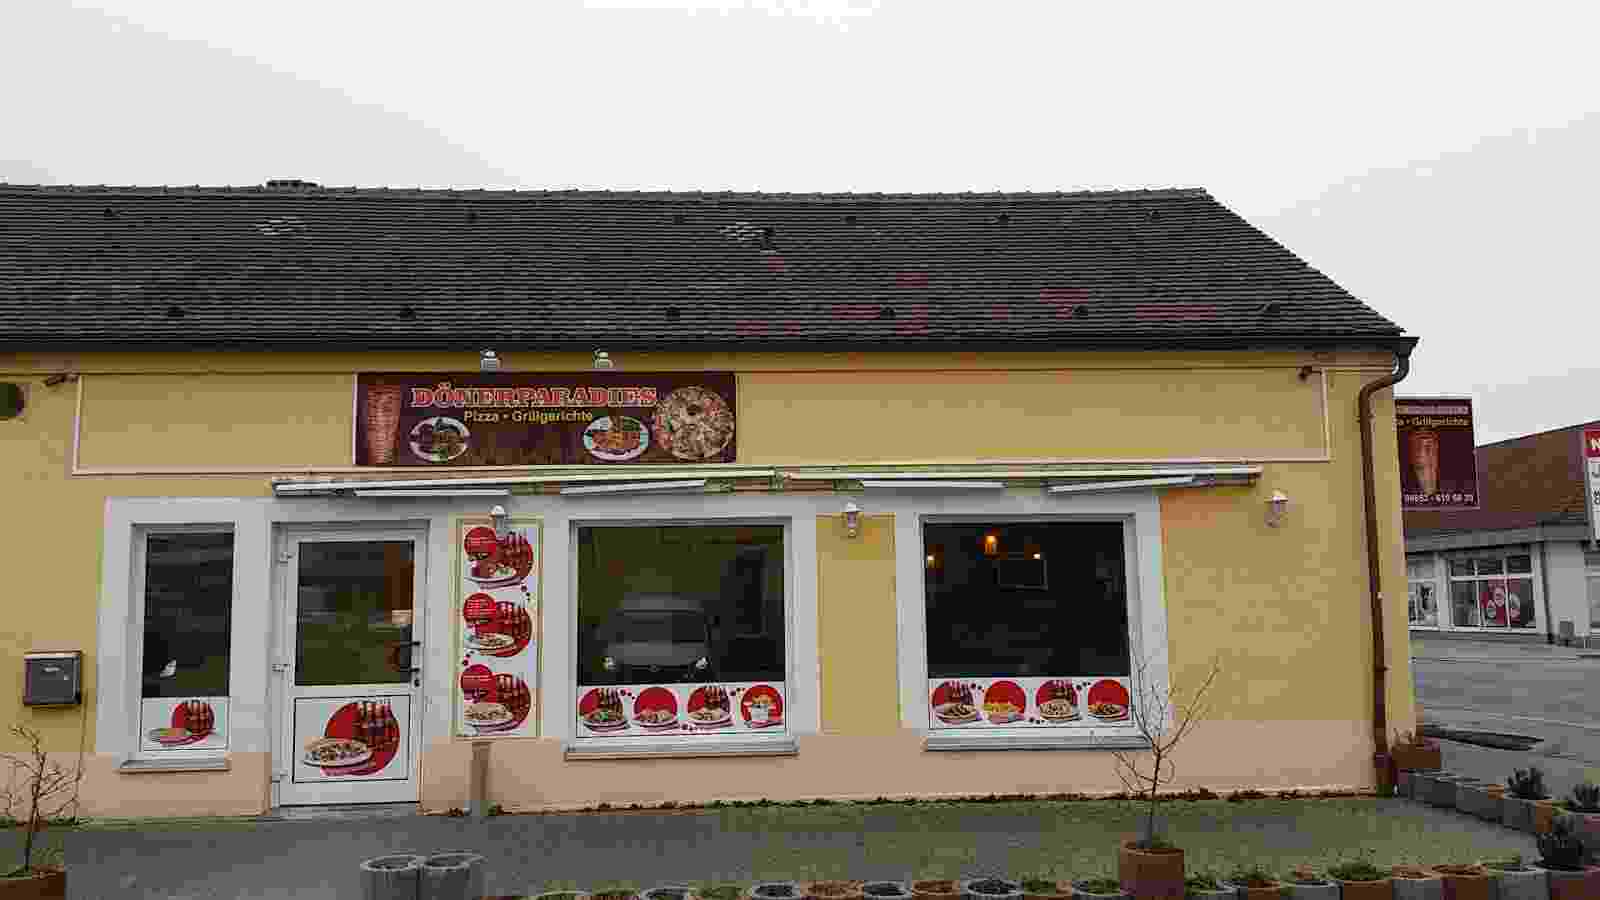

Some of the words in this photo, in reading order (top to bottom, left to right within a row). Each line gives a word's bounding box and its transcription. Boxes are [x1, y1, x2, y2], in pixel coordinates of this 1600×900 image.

[411, 382, 657, 408] DÖNERPARADIES
[464, 410, 499, 423] Pizza
[511, 409, 593, 425] Grillgerichte
